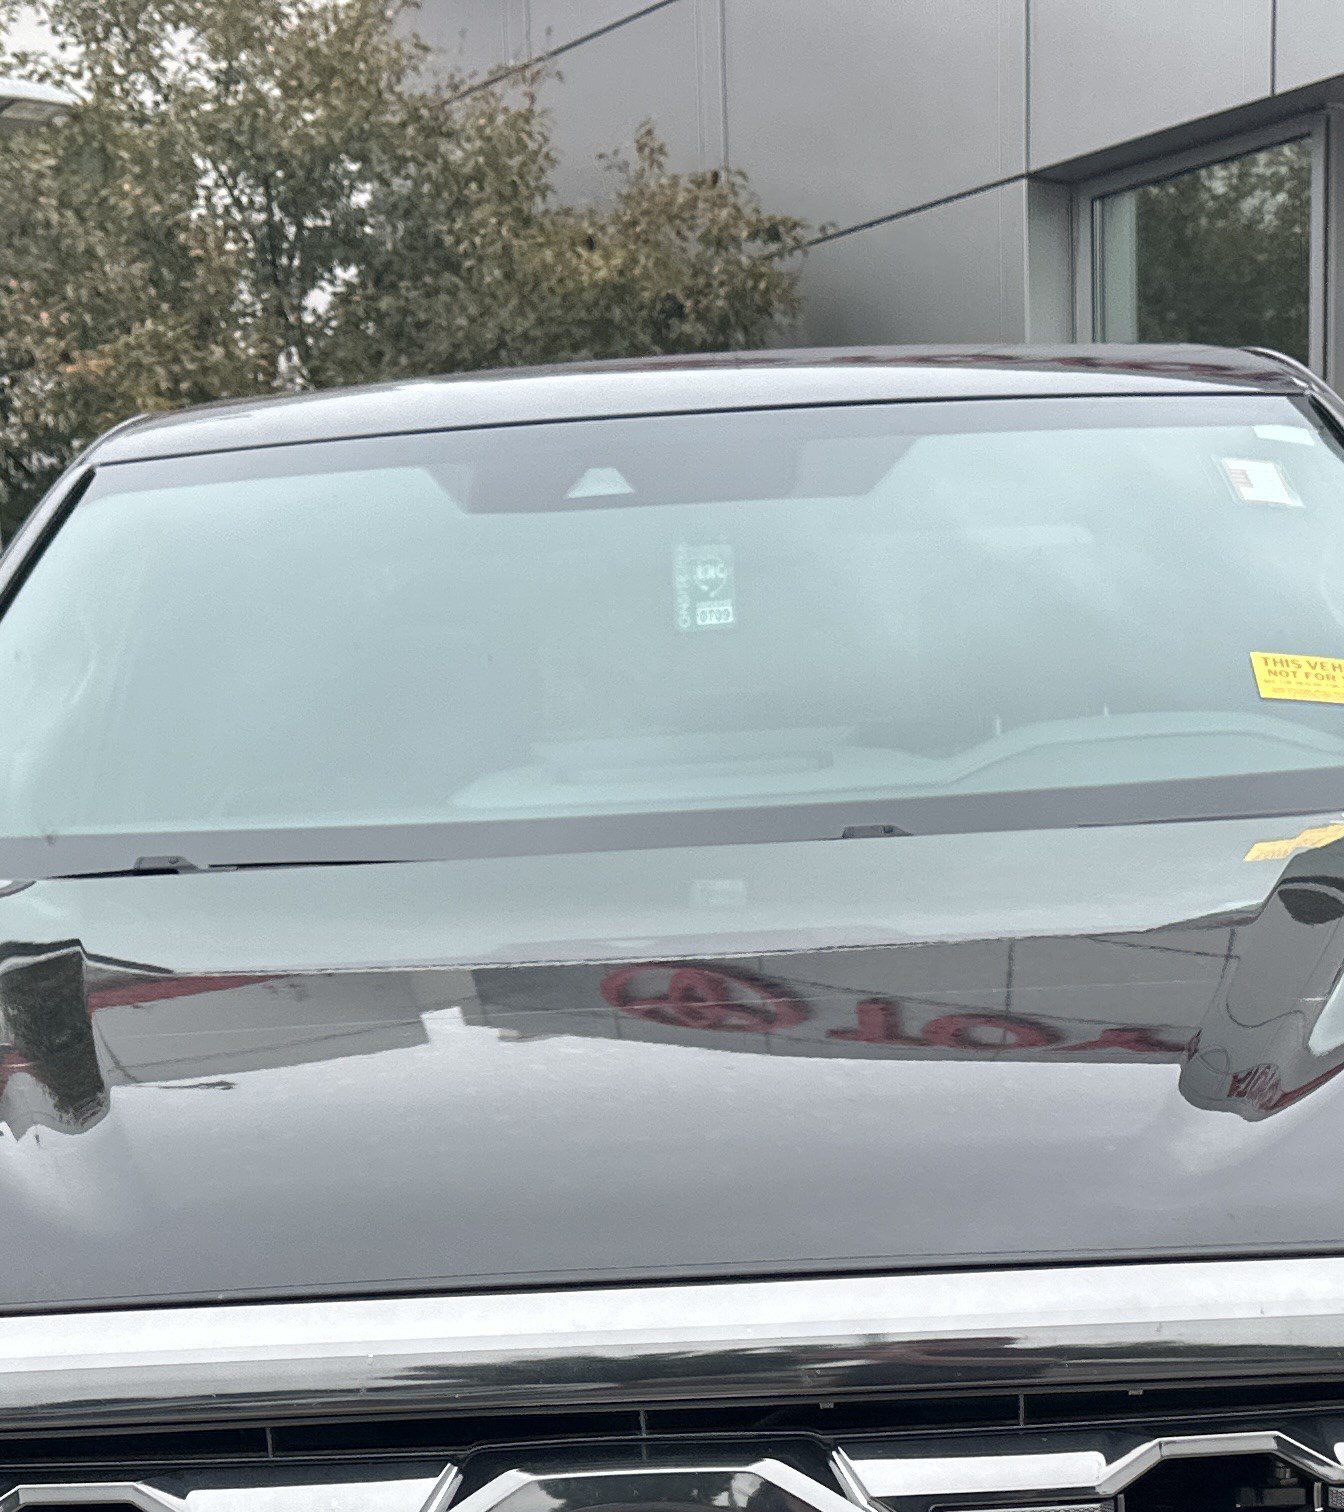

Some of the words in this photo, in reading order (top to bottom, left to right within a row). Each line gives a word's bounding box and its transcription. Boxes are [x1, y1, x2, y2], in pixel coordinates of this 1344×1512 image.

[1261, 656, 1303, 669] THIS
[1267, 669, 1299, 679] NOT
[1305, 671, 1337, 682] FOR
